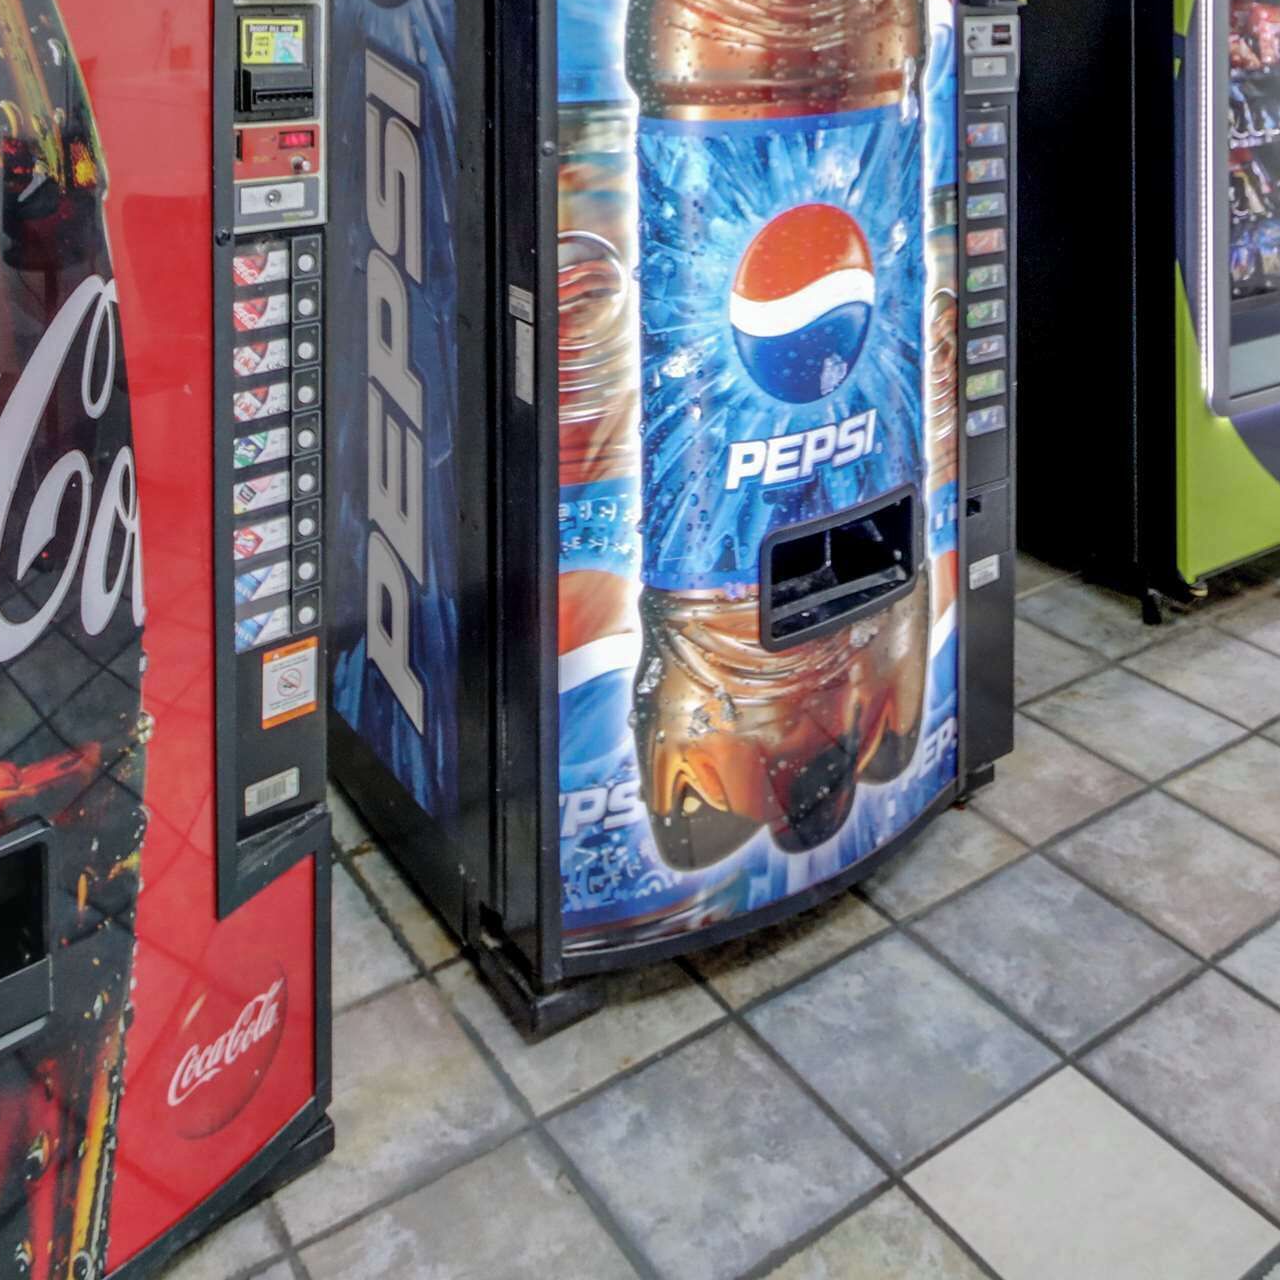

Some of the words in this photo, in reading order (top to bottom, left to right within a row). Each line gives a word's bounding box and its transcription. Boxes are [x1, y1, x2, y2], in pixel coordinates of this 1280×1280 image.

[364, 47, 424, 736] PEPSI
[725, 409, 877, 490] PEPSI
[559, 780, 647, 837] PS
[168, 977, 285, 1107] Coca-Cola
